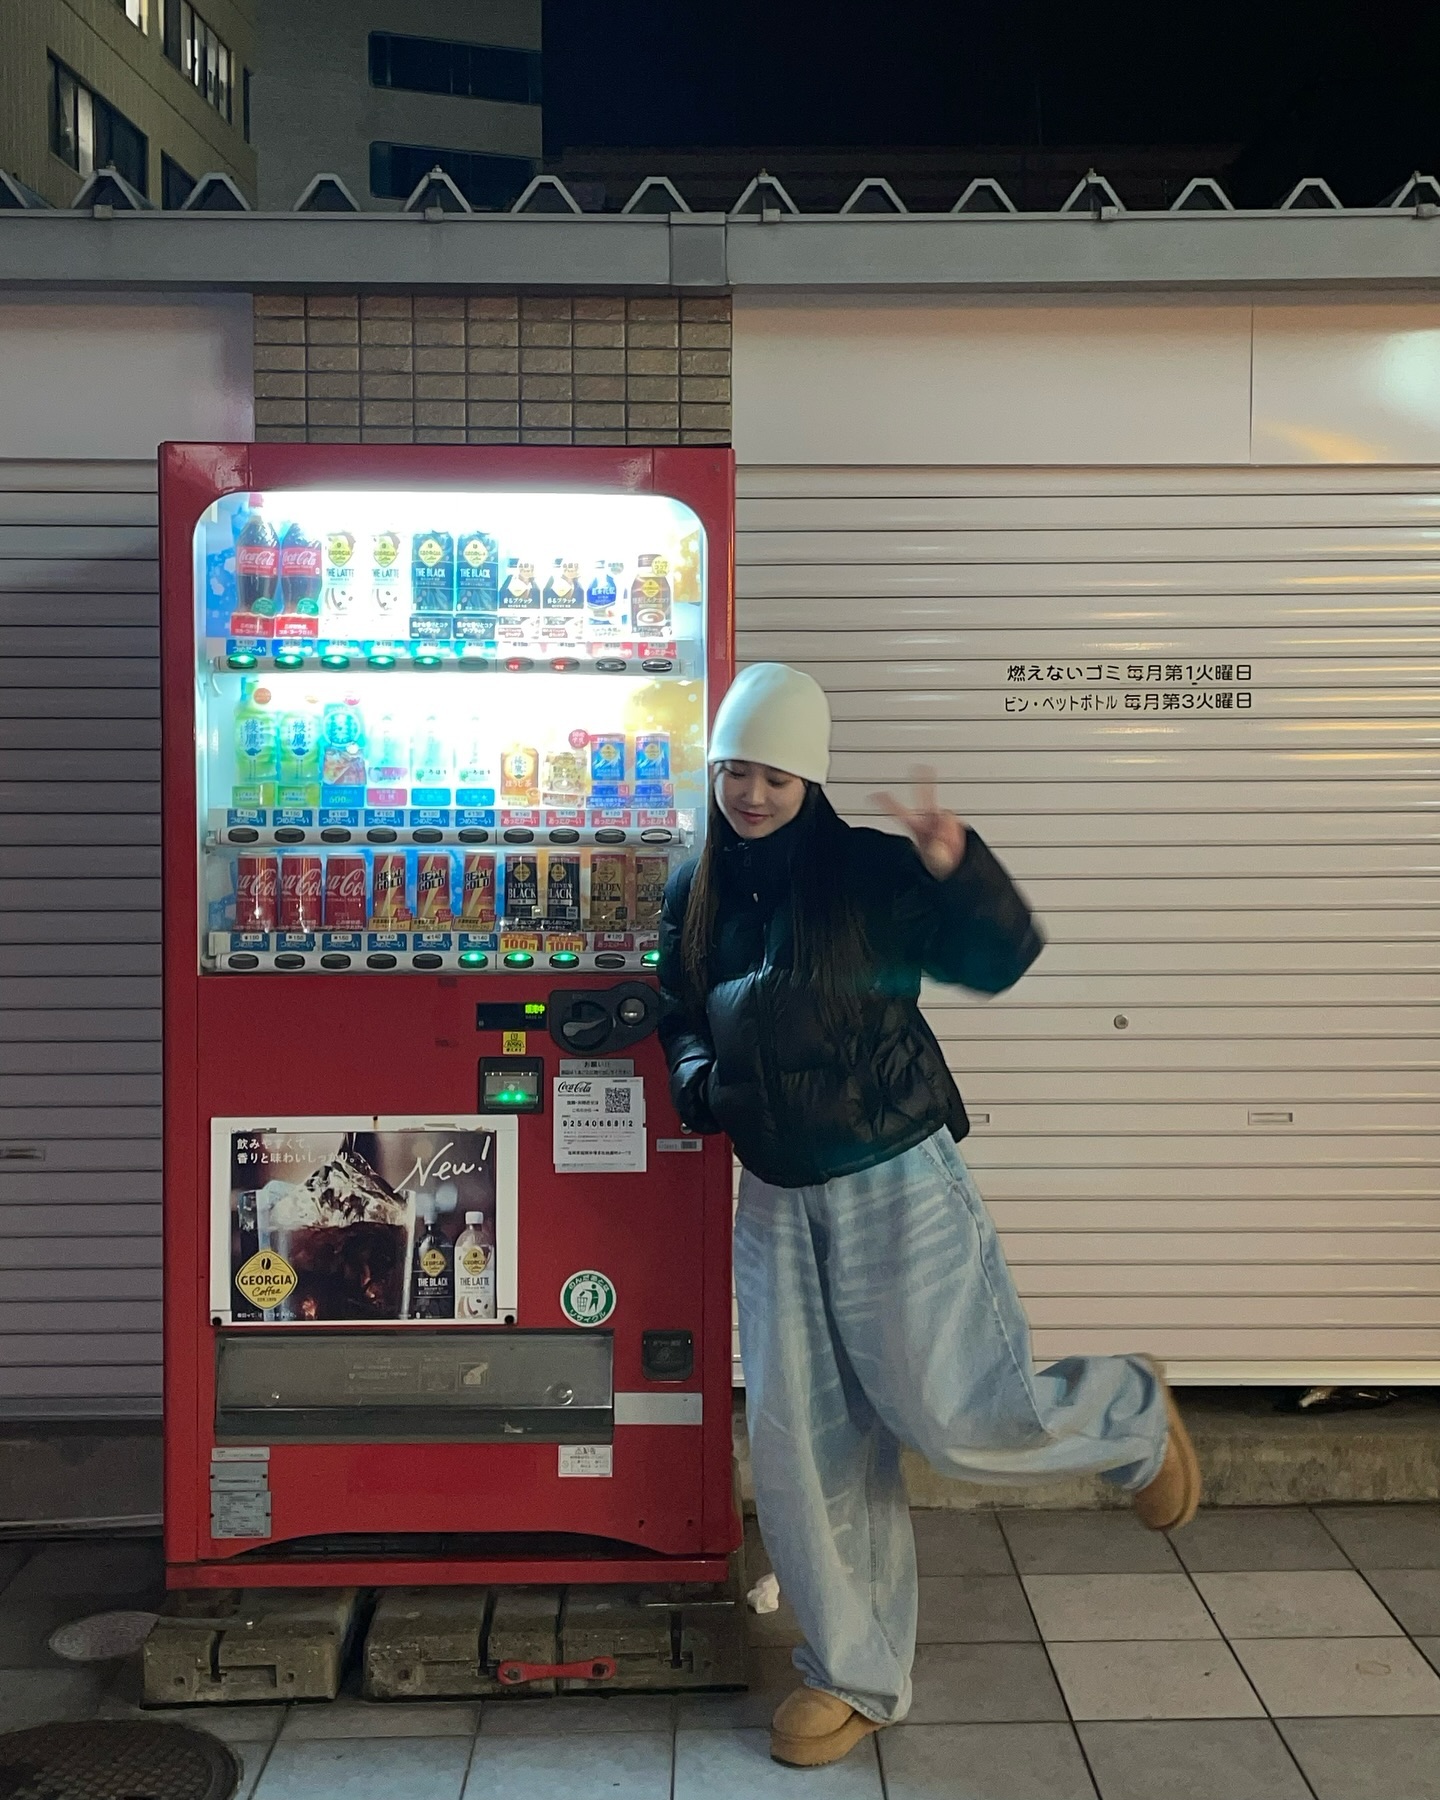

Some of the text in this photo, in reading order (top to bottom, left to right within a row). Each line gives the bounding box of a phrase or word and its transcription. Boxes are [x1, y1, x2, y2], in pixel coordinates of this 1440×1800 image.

[239, 549, 275, 566] Coca-Cola
[282, 550, 317, 566] Coca-Cola
[337, 568, 354, 577] LATTE
[382, 569, 399, 578] LATTE
[415, 568, 446, 577] THE BLACK
[460, 568, 490, 578] THE BLACK
[1006, 664, 1252, 682] 燃えないゴミ 毎月第1火曜日
[1004, 692, 1252, 713] ビン・ペットボトル 毎月第3火曜日
[244, 719, 258, 748] 綾鷹
[377, 867, 404, 882] REAL
[418, 867, 446, 882] REAL
[464, 867, 492, 882] REAL
[376, 877, 403, 891] GOLD
[418, 878, 445, 891] GOLD
[465, 877, 491, 891] GOLD
[508, 888, 537, 899] BLACK
[549, 888, 573, 899] LACK
[503, 938, 536, 951] 100円
[557, 1080, 592, 1093] Coca-Cola
[237, 1151, 355, 1165] 香りと味わいしっかり。
[393, 1135, 492, 1193] New!
[240, 1275, 293, 1286] GEORGIA
[417, 1278, 448, 1288] THE BLACK
[460, 1277, 490, 1286] THE LATTE
[568, 1274, 610, 1293] のんだあとは
[252, 1285, 282, 1298] Coffee
[569, 1309, 606, 1323] リサイクル
